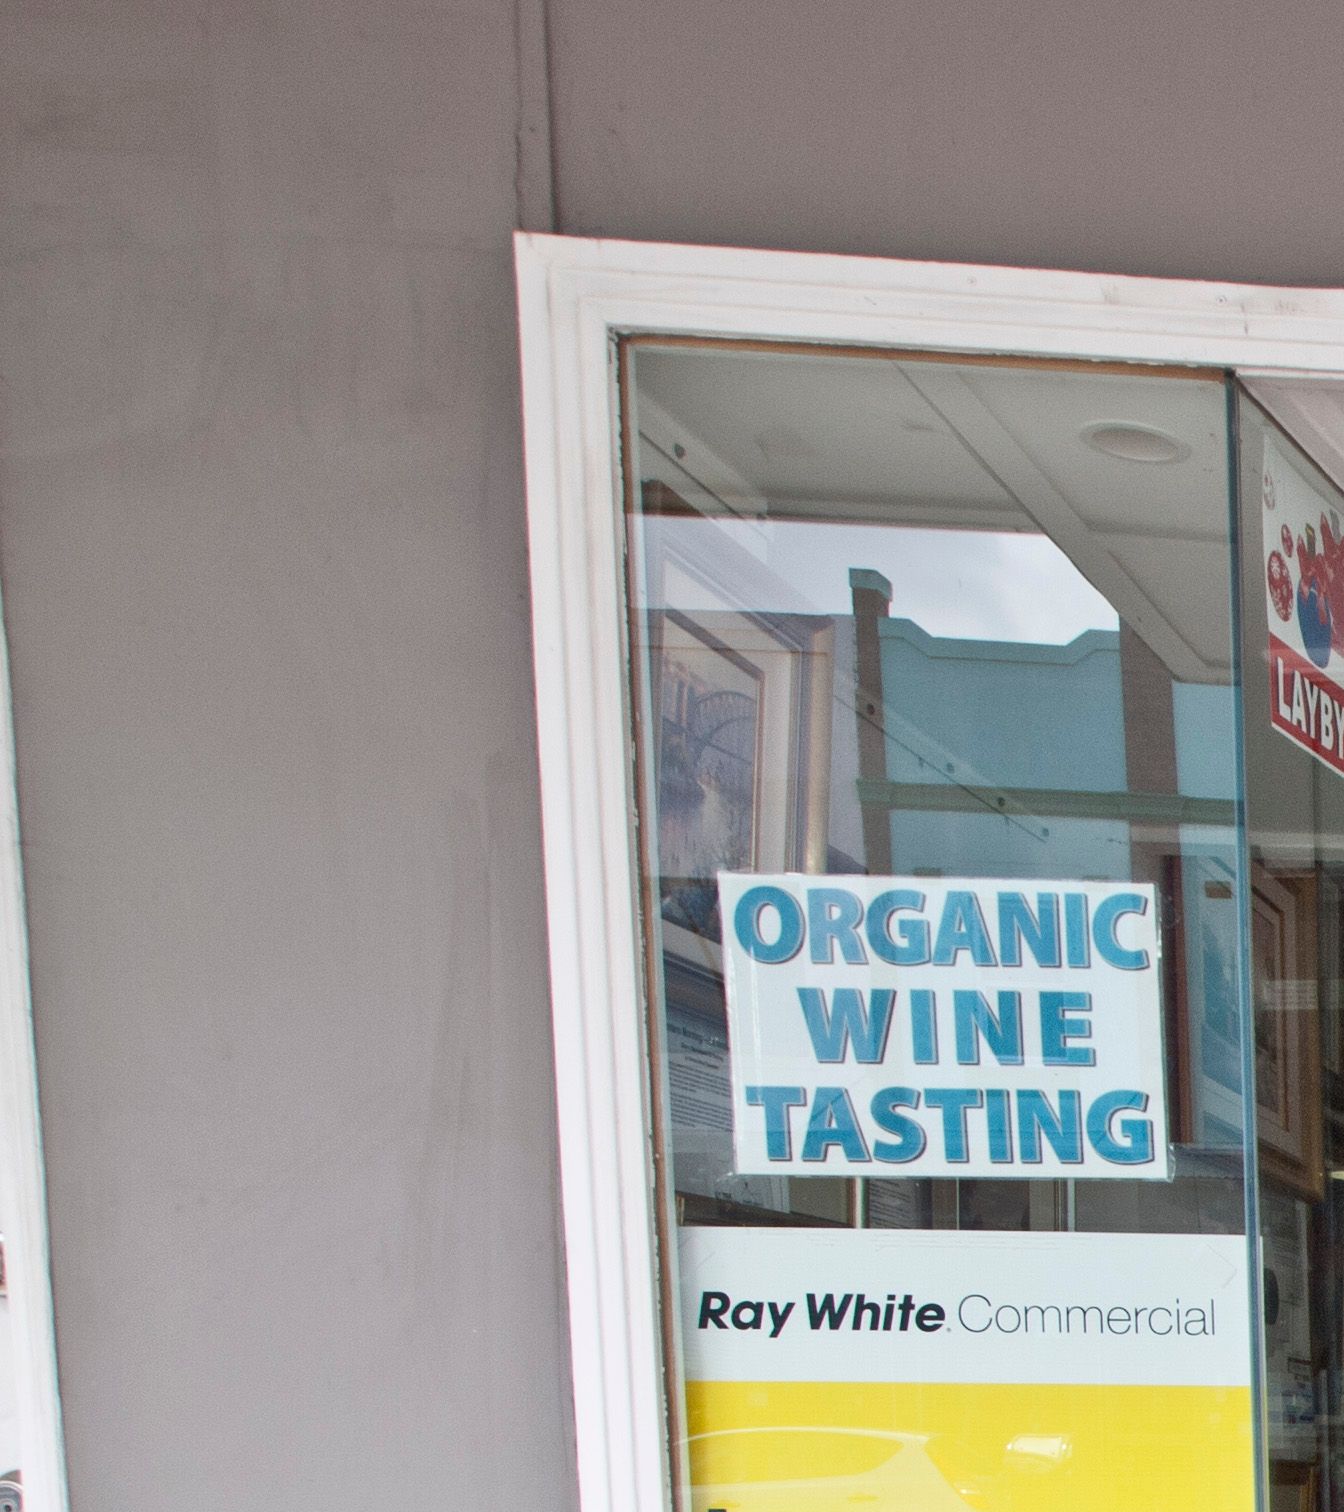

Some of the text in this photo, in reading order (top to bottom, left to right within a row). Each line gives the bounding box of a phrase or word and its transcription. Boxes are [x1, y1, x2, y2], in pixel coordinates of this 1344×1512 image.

[732, 885, 1150, 971] ORGANIC
[797, 987, 1097, 1067] WINE
[745, 1085, 1156, 1165] TASTING
[698, 1291, 796, 1339] Ray
[957, 1294, 1217, 1336] Commercial
